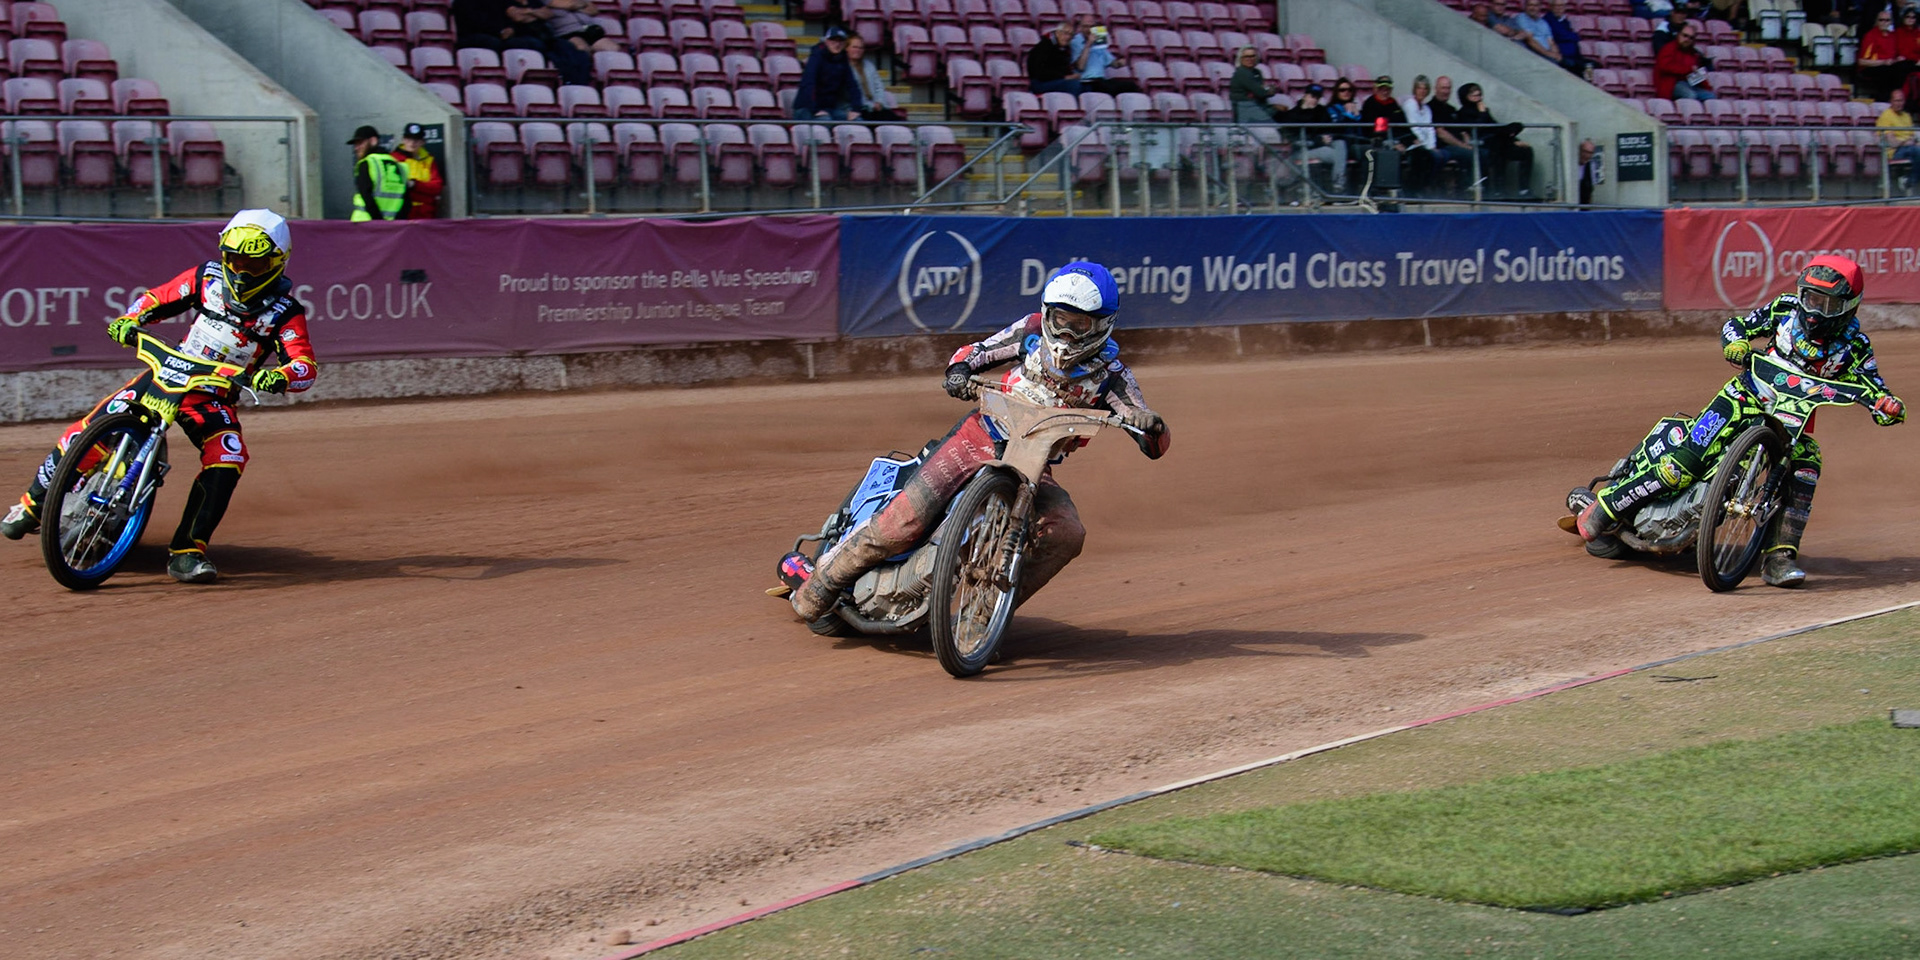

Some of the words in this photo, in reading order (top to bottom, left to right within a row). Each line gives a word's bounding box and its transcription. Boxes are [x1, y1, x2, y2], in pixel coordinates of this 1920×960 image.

[1202, 253, 1296, 293] World
[1306, 252, 1386, 289] Class
[1396, 248, 1485, 286] Travel
[1493, 247, 1624, 283] Solutions
[1721, 252, 1764, 277] ATPI
[500, 272, 548, 293] Proud
[552, 274, 569, 292] to
[572, 274, 637, 294] sponsor
[641, 270, 667, 288] the
[670, 270, 708, 288] Belle
[712, 270, 740, 287] Vue
[744, 267, 818, 290] Speedway
[913, 266, 967, 297] ATPI
[537, 302, 632, 323] Premiership
[635, 301, 683, 320] Junior
[687, 300, 740, 320] League
[745, 299, 785, 316] Team
[164, 355, 195, 371] FRISKY
[961, 439, 981, 461] Ellie
[1611, 495, 1635, 512] Linda
